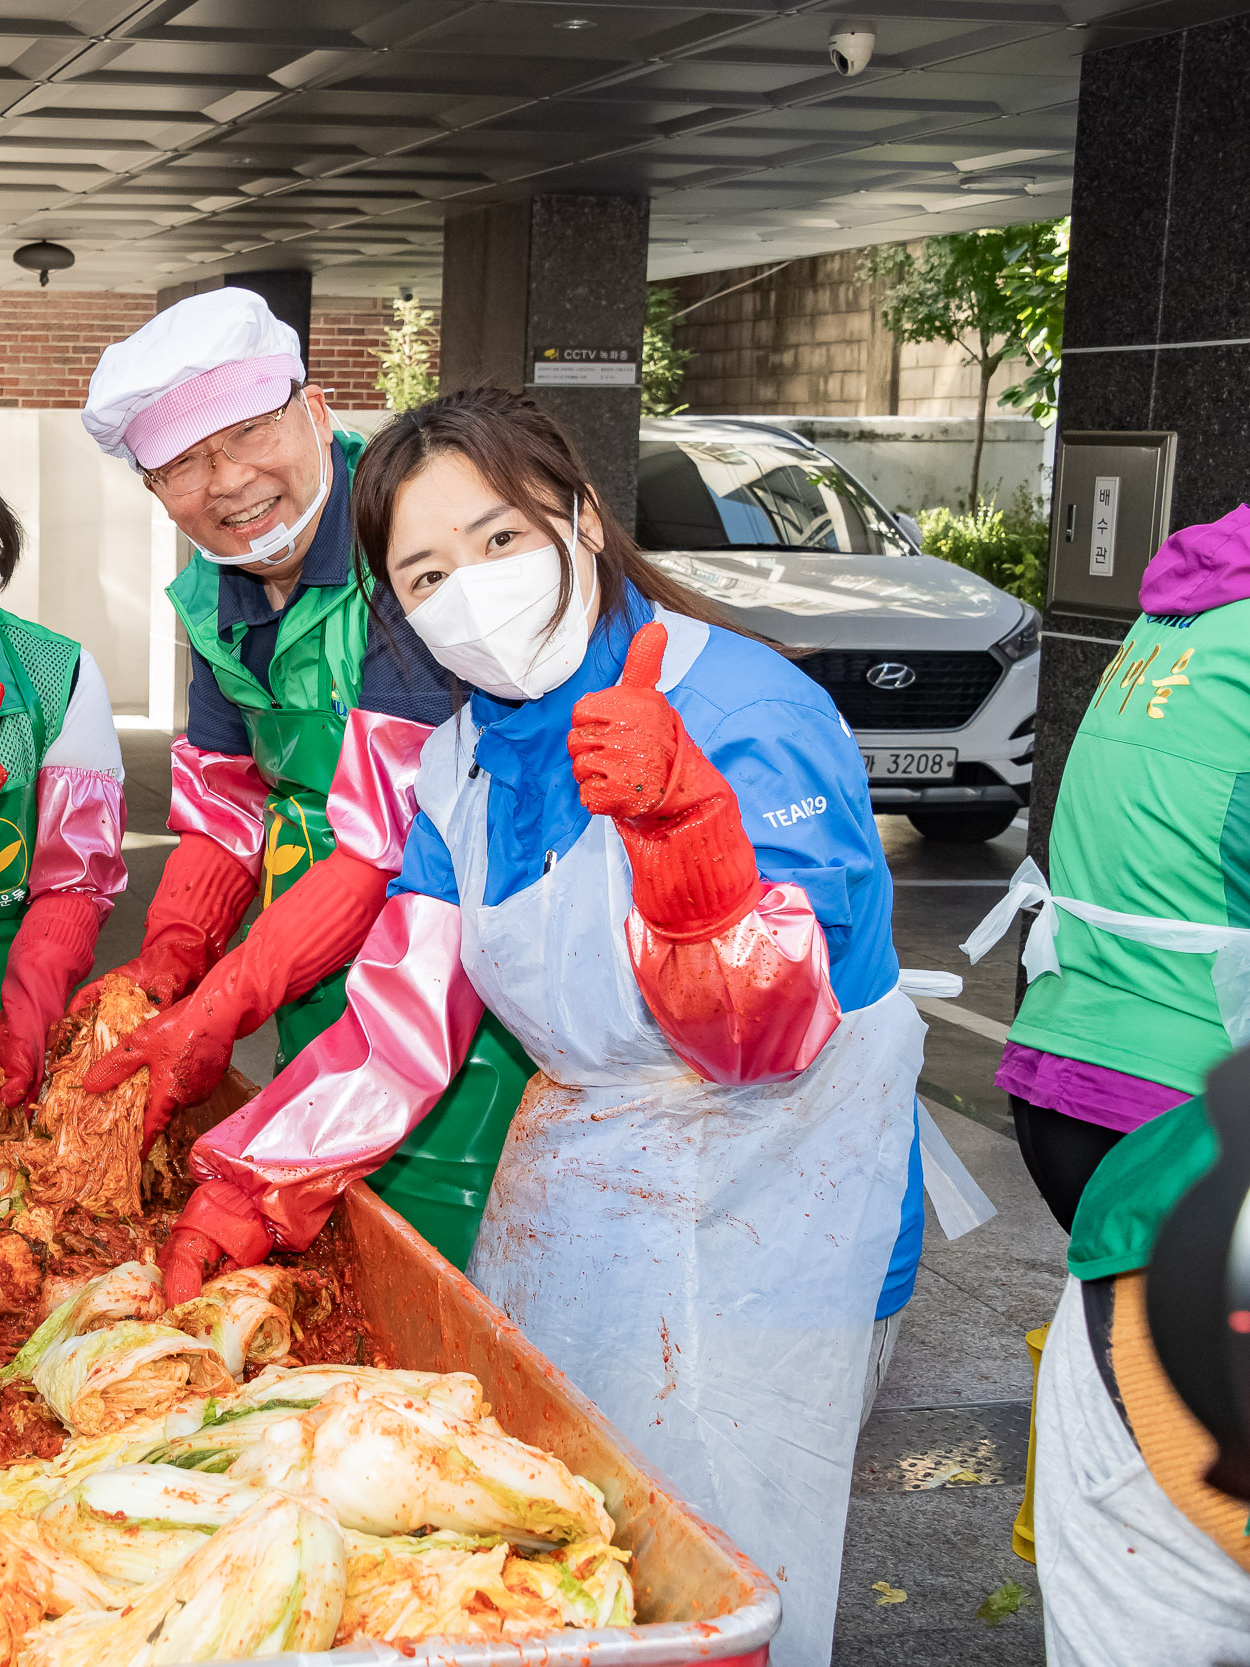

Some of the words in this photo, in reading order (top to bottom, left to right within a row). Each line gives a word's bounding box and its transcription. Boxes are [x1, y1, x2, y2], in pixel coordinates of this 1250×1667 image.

[564, 349, 597, 360] CCTV
[599, 350, 628, 360] 녹화중
[1095, 489, 1111, 564] 배수관
[887, 753, 943, 774] 3208
